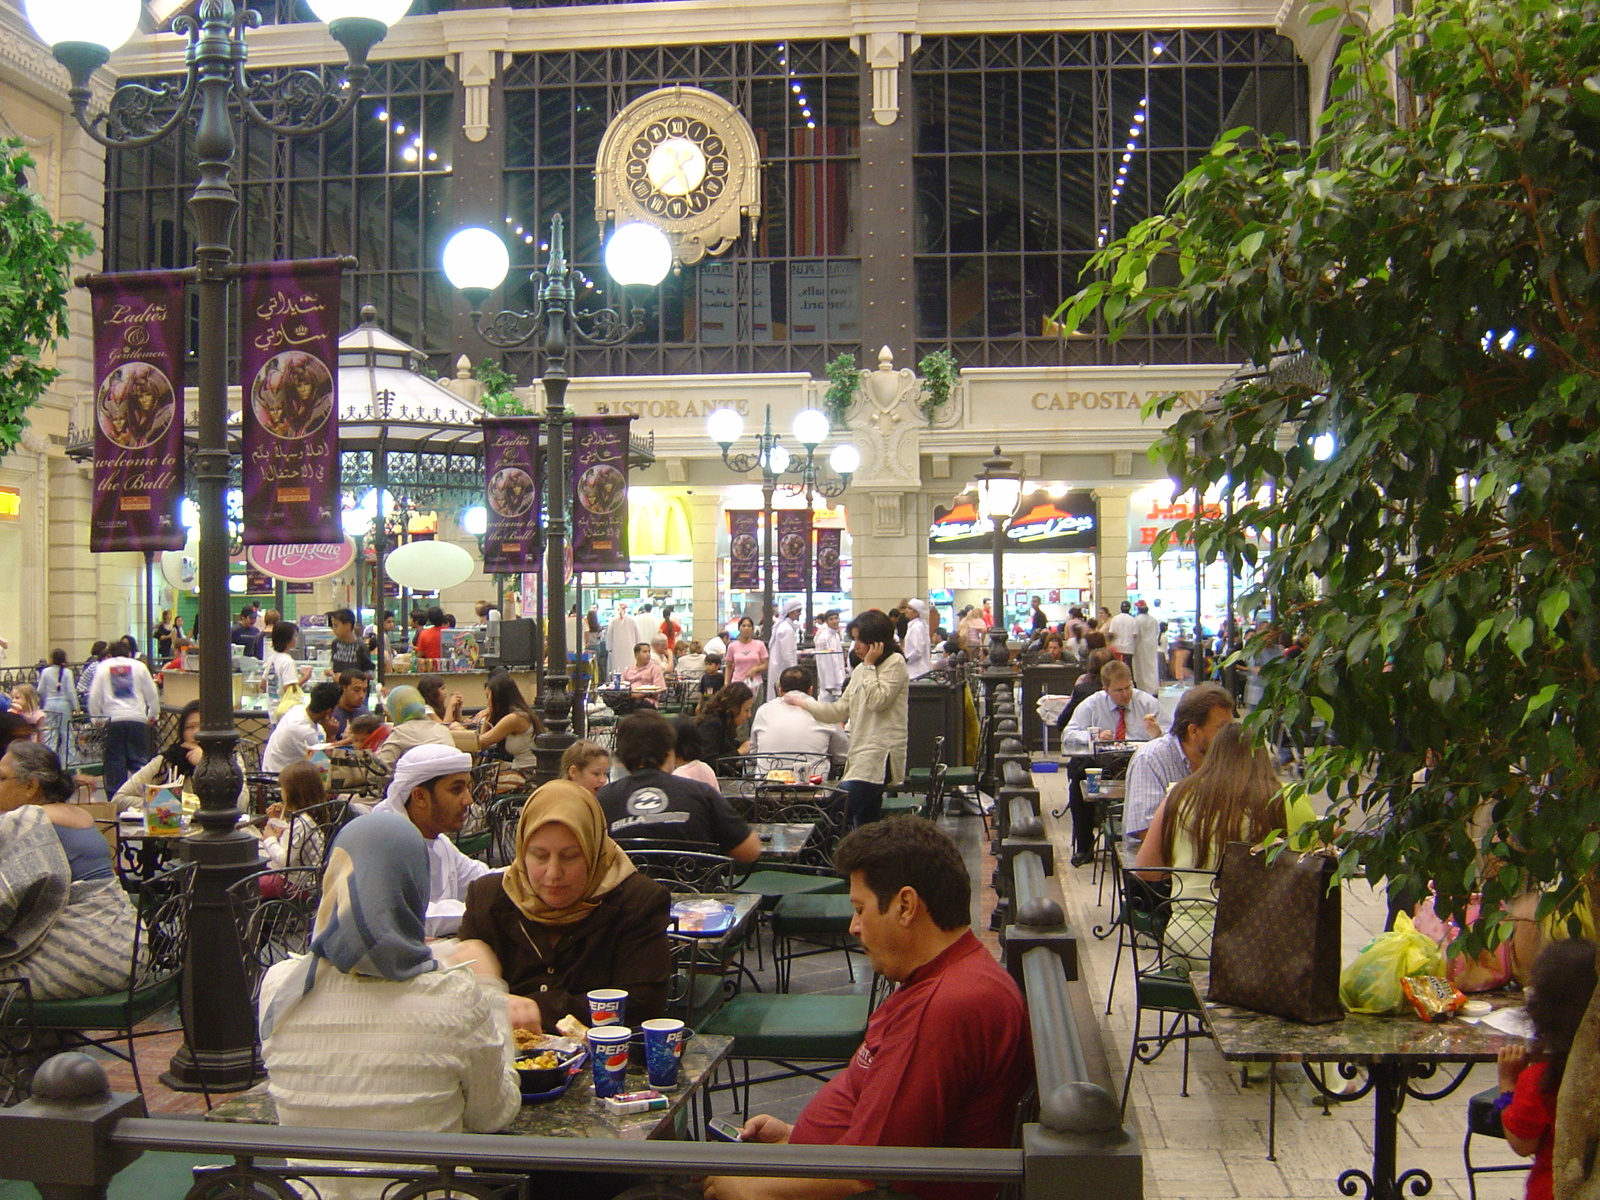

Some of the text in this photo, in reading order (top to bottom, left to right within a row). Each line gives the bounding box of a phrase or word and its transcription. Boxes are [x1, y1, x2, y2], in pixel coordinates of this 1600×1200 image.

[104, 303, 168, 324] Ladies
[124, 325, 150, 346] &
[491, 434, 530, 447] Ladies
[95, 450, 176, 469] welcome to
[97, 469, 177, 491] the Ball!
[589, 1000, 619, 1011] PEPSI
[596, 1044, 630, 1056] PEPS
